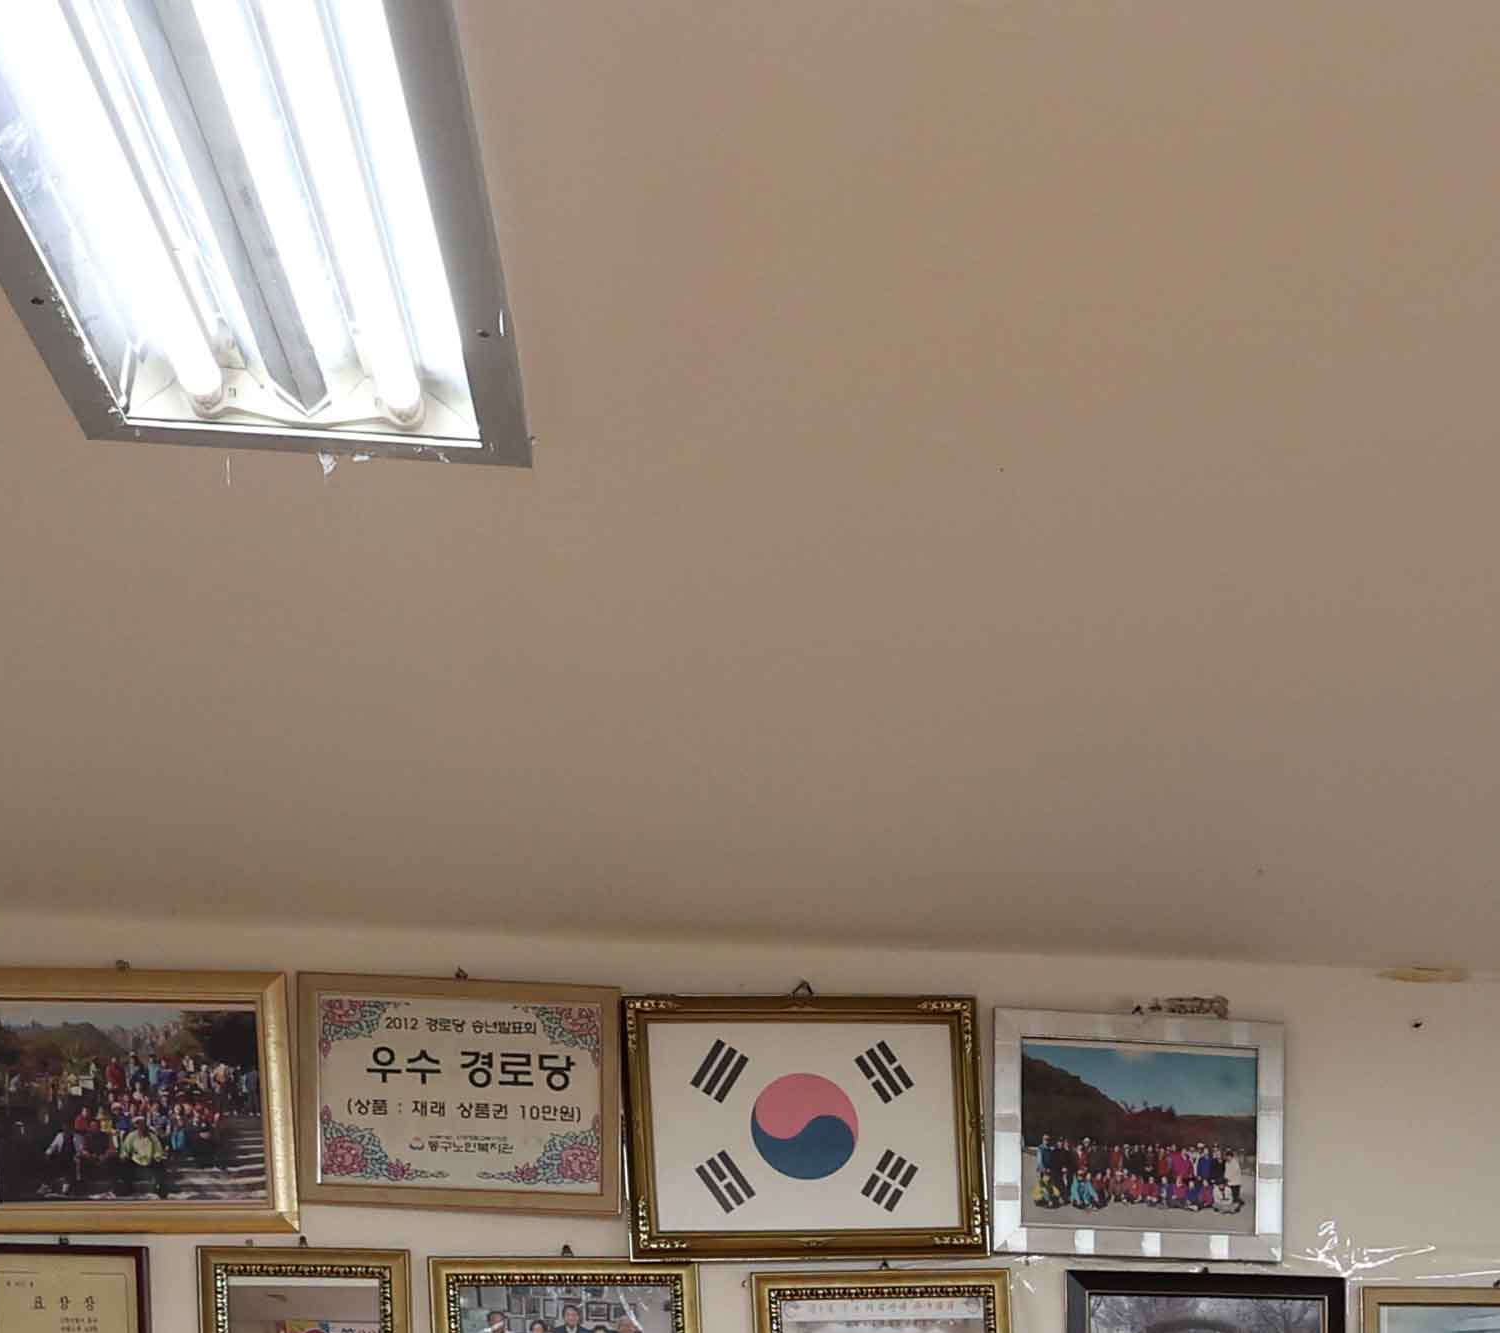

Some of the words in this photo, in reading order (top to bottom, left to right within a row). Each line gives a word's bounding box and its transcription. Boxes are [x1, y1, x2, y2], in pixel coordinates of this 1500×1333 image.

[384, 1016, 419, 1031] 2012
[425, 1016, 466, 1033] 경로당
[366, 1046, 442, 1085] 우수
[460, 1050, 576, 1092] 경로당
[347, 1097, 388, 1116] (상품
[411, 1100, 446, 1117] 재래
[456, 1102, 509, 1120] 상품권
[519, 1104, 581, 1123] 10만원)
